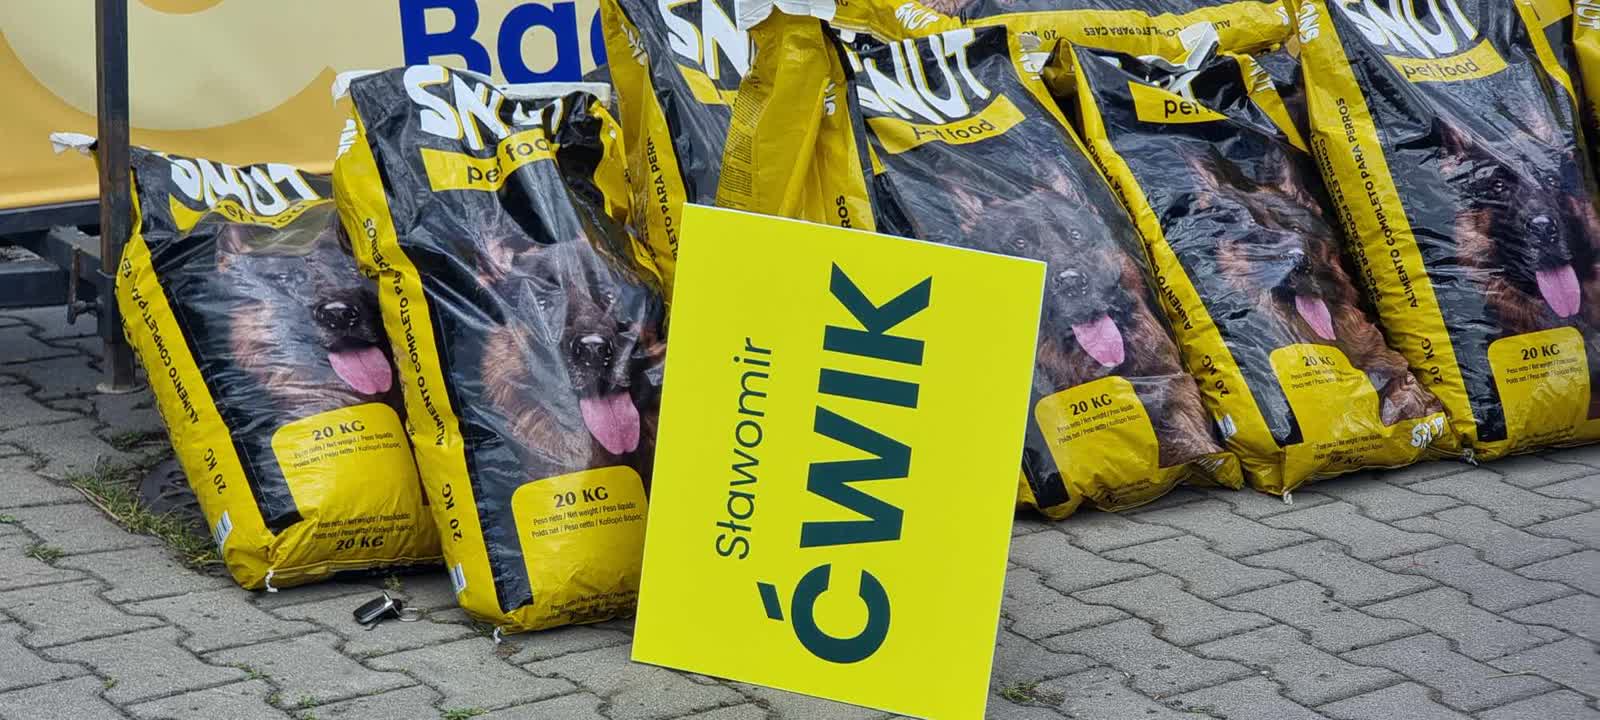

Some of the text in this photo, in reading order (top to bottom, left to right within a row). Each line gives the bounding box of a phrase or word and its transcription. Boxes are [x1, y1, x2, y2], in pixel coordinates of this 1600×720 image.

[399, 0, 608, 84] Ba
[1402, 58, 1480, 79] pet food
[506, 136, 551, 162] foo
[655, 174, 670, 214] PARA
[835, 194, 852, 228] ROS
[1336, 97, 1419, 309] ALIMENTO COMPLETO PARA PERROS
[142, 310, 173, 365] COMPLET
[400, 296, 422, 374] COMPLETO
[1521, 343, 1561, 361] 20 KG
[1302, 355, 1318, 367] 20
[1420, 338, 1444, 385] 20 KG
[416, 374, 446, 447] ALIMENTO
[1070, 400, 1089, 416] 20
[1091, 393, 1112, 409] KG
[312, 419, 366, 441] 20 KG
[716, 336, 773, 561] Sławomir
[756, 260, 934, 665] ĆWIK
[213, 472, 227, 495] 20
[552, 485, 610, 509] 20 KG
[441, 483, 464, 542] 20 KG
[336, 536, 385, 551] 20 KG
